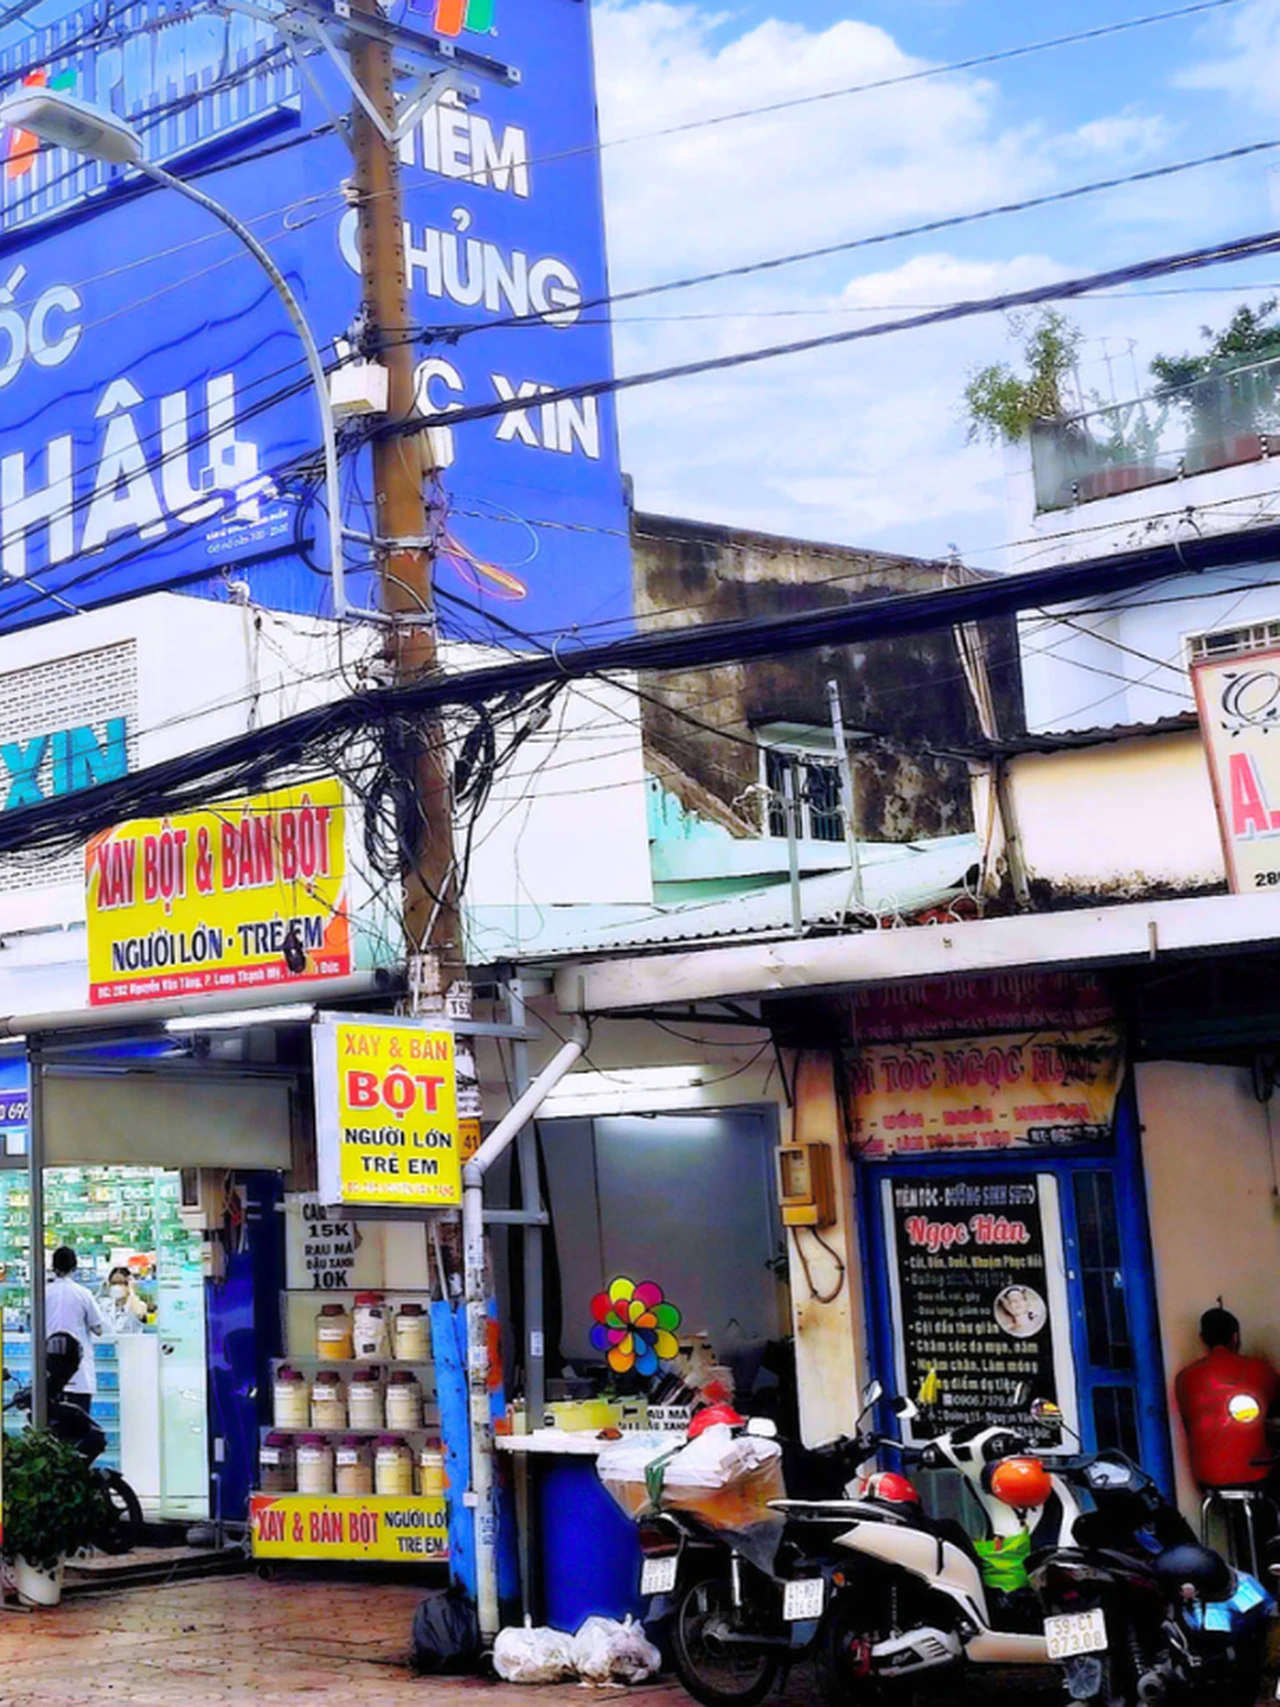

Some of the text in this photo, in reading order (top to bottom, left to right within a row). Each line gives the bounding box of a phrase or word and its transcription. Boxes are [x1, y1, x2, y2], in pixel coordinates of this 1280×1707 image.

[490, 373, 601, 460] XIN
[97, 795, 332, 915] XAY BỘT & BÁN BỘT
[112, 926, 176, 972] NGƯỜI
[179, 920, 223, 964] LỚN
[345, 1033, 381, 1056] XAY
[388, 1036, 403, 1059] &
[348, 1064, 445, 1120] BỘT
[8, 1101, 29, 1120] 692
[345, 1126, 452, 1148] NGƯỜI LỚN
[361, 1152, 438, 1175] TRẺ EM
[308, 1223, 350, 1238] 15K
[905, 1214, 1031, 1253] Ngọc Hân
[313, 1270, 348, 1289] 10K
[257, 1510, 286, 1542] XAY
[292, 1512, 304, 1543] &
[349, 1504, 379, 1552] BỘT
